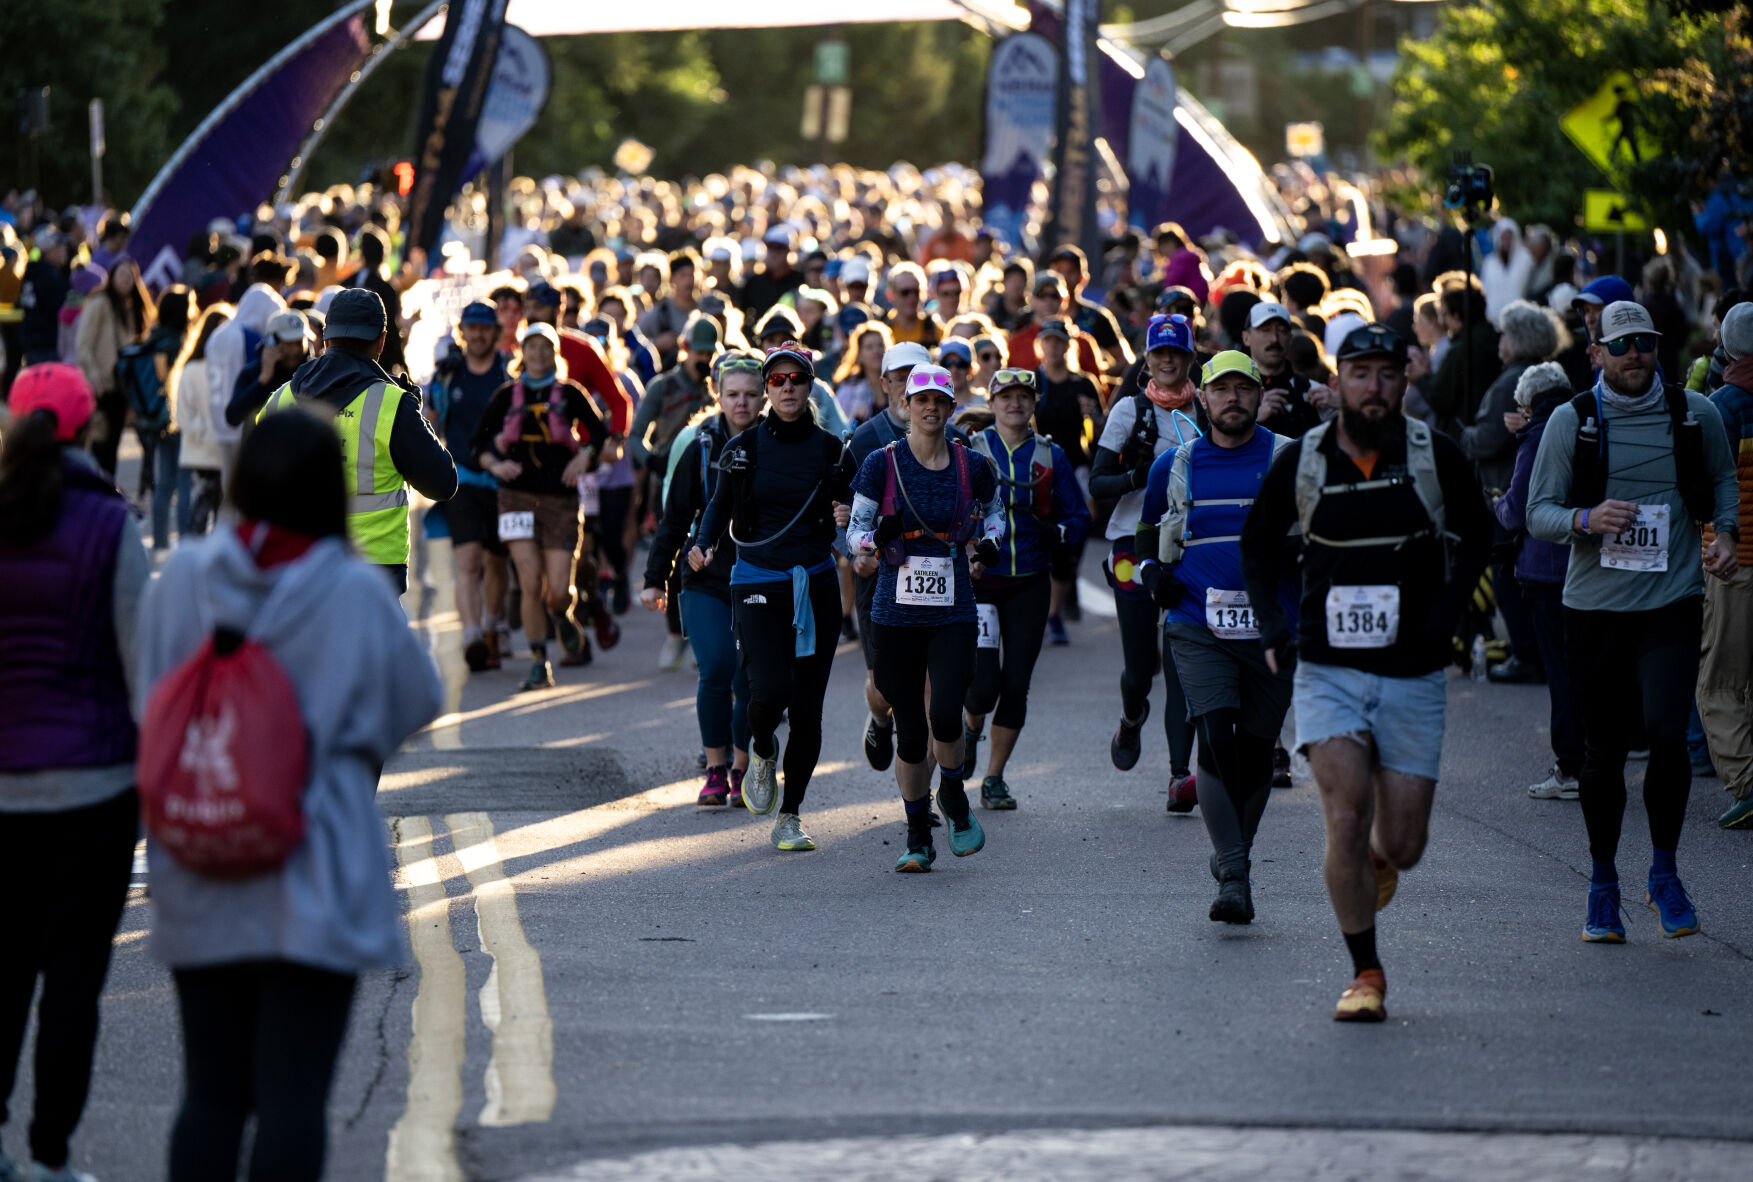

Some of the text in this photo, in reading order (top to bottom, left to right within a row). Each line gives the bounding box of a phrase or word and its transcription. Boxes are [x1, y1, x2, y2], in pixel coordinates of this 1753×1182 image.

[1612, 527, 1658, 547] 1301
[905, 575, 946, 594] 1328
[1336, 611, 1388, 633] 1384
